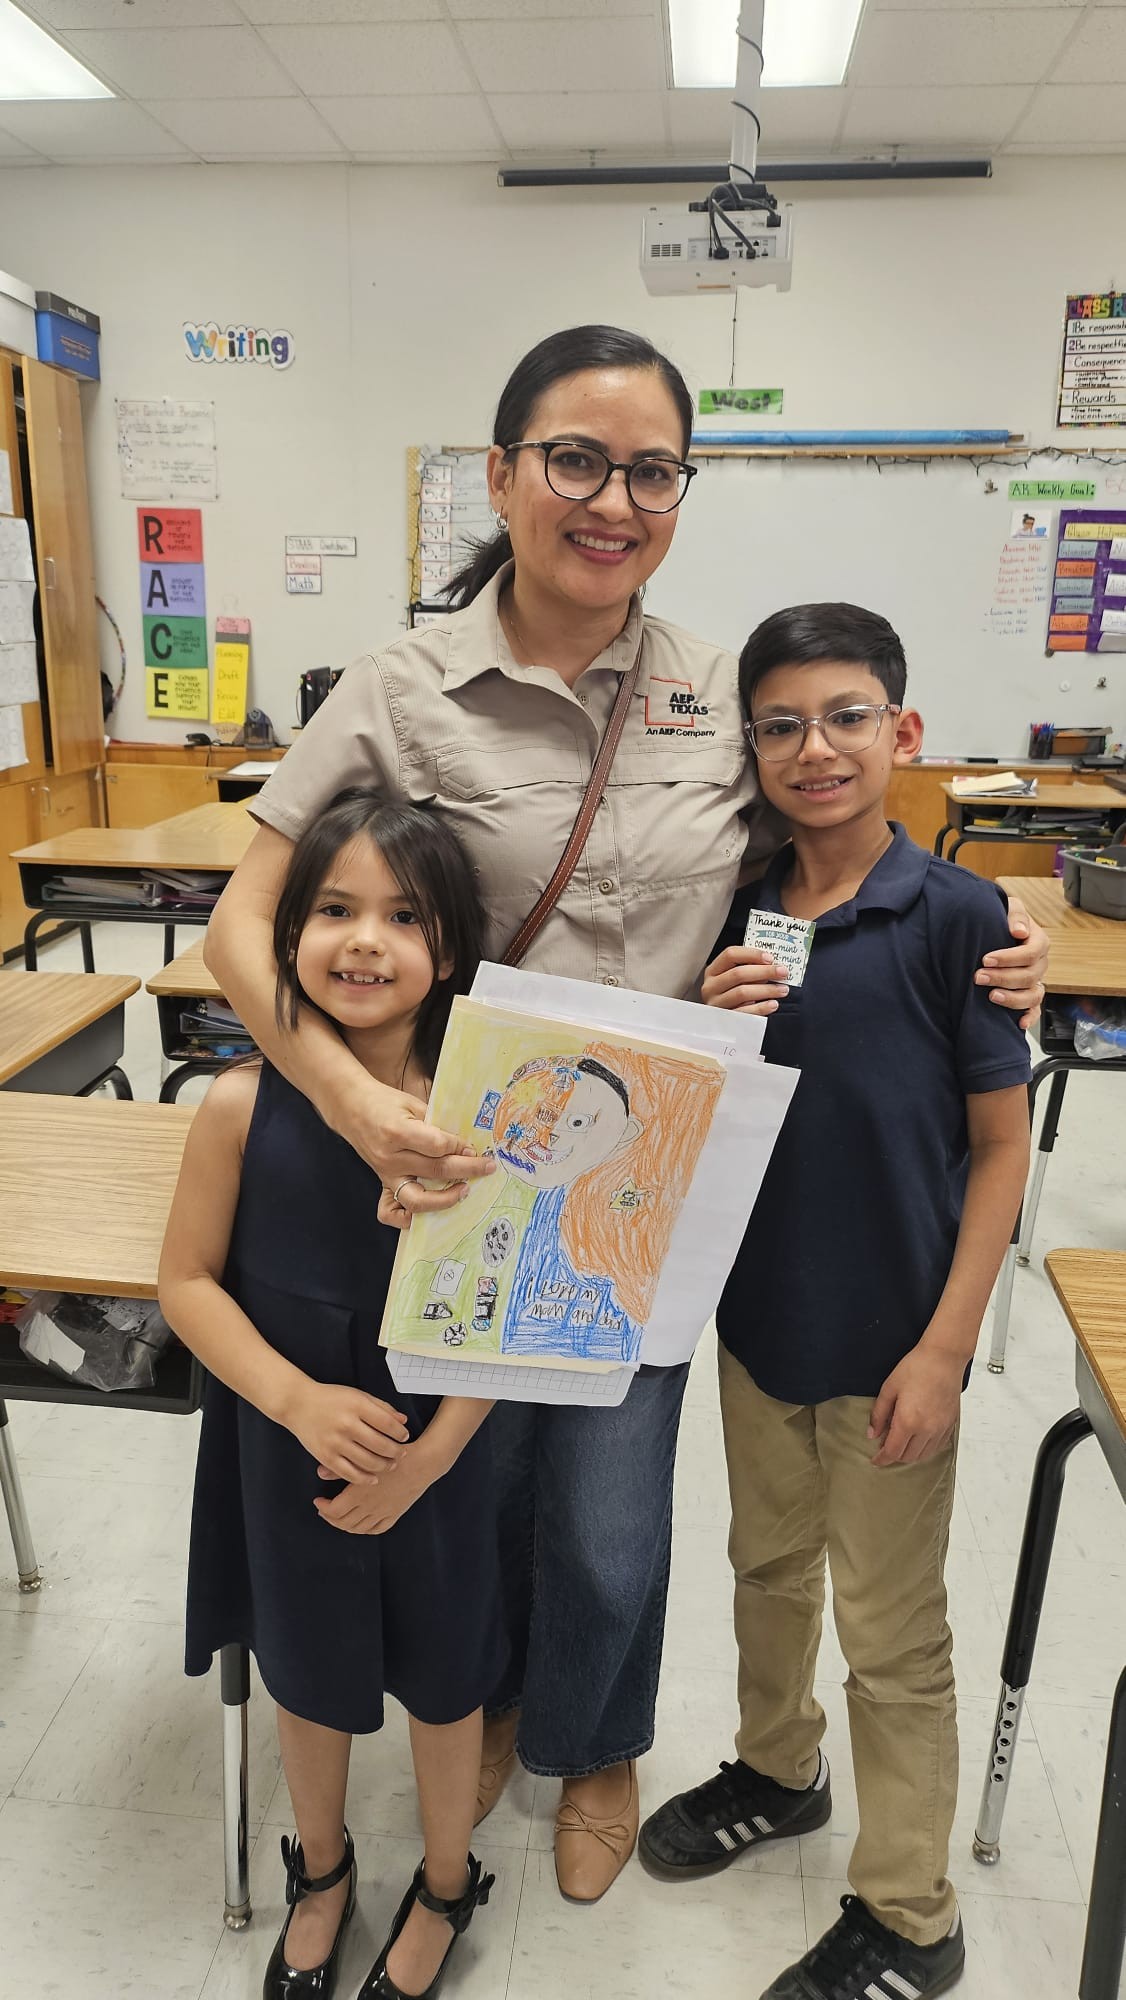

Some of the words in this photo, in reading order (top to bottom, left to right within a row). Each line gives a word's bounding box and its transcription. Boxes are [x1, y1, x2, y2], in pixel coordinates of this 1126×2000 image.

[1069, 299, 1110, 318] CLASS
[185, 330, 289, 364] Writing
[711, 391, 770, 410] West
[1072, 389, 1116, 403] Rewards
[1037, 483, 1065, 498] Weekly
[424, 506, 448, 521] 5.3
[143, 515, 165, 555] R
[147, 569, 169, 608] A
[288, 576, 314, 590] Math
[150, 623, 172, 659] C
[154, 673, 169, 708] E
[670, 692, 695, 704] AEP
[669, 703, 709, 715] TEXAS
[659, 728, 675, 736] AEP
[676, 729, 716, 738] Company
[753, 914, 785, 928] Thank
[786, 922, 808, 934] you
[754, 940, 798, 954] COMMIT-mint
